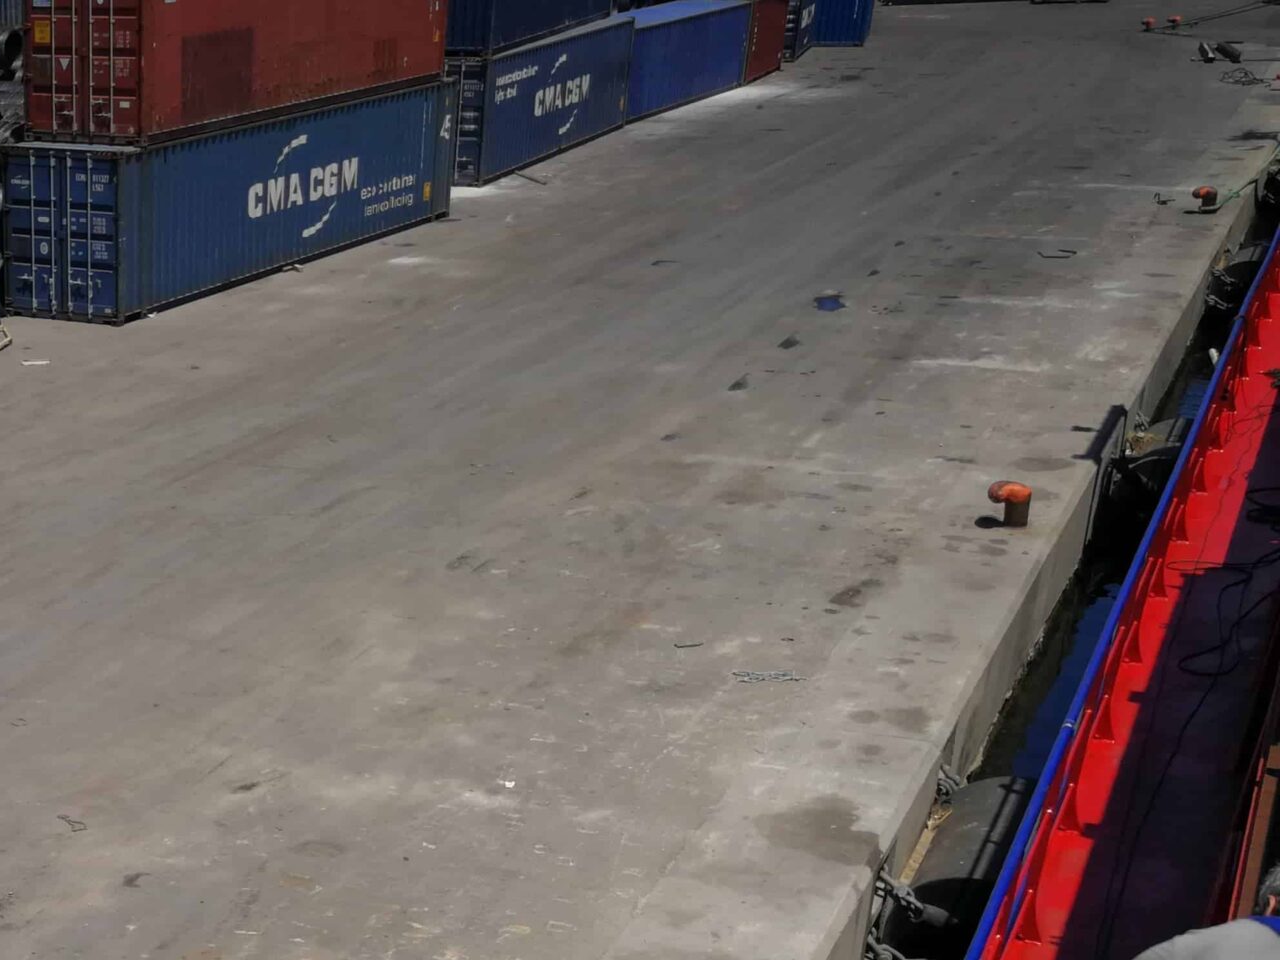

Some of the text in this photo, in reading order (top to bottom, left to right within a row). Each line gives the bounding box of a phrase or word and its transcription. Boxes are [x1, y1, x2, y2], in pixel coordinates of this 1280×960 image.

[534, 82, 562, 117] CMA
[564, 73, 591, 107] CGM
[247, 156, 360, 219] CMA CGM
